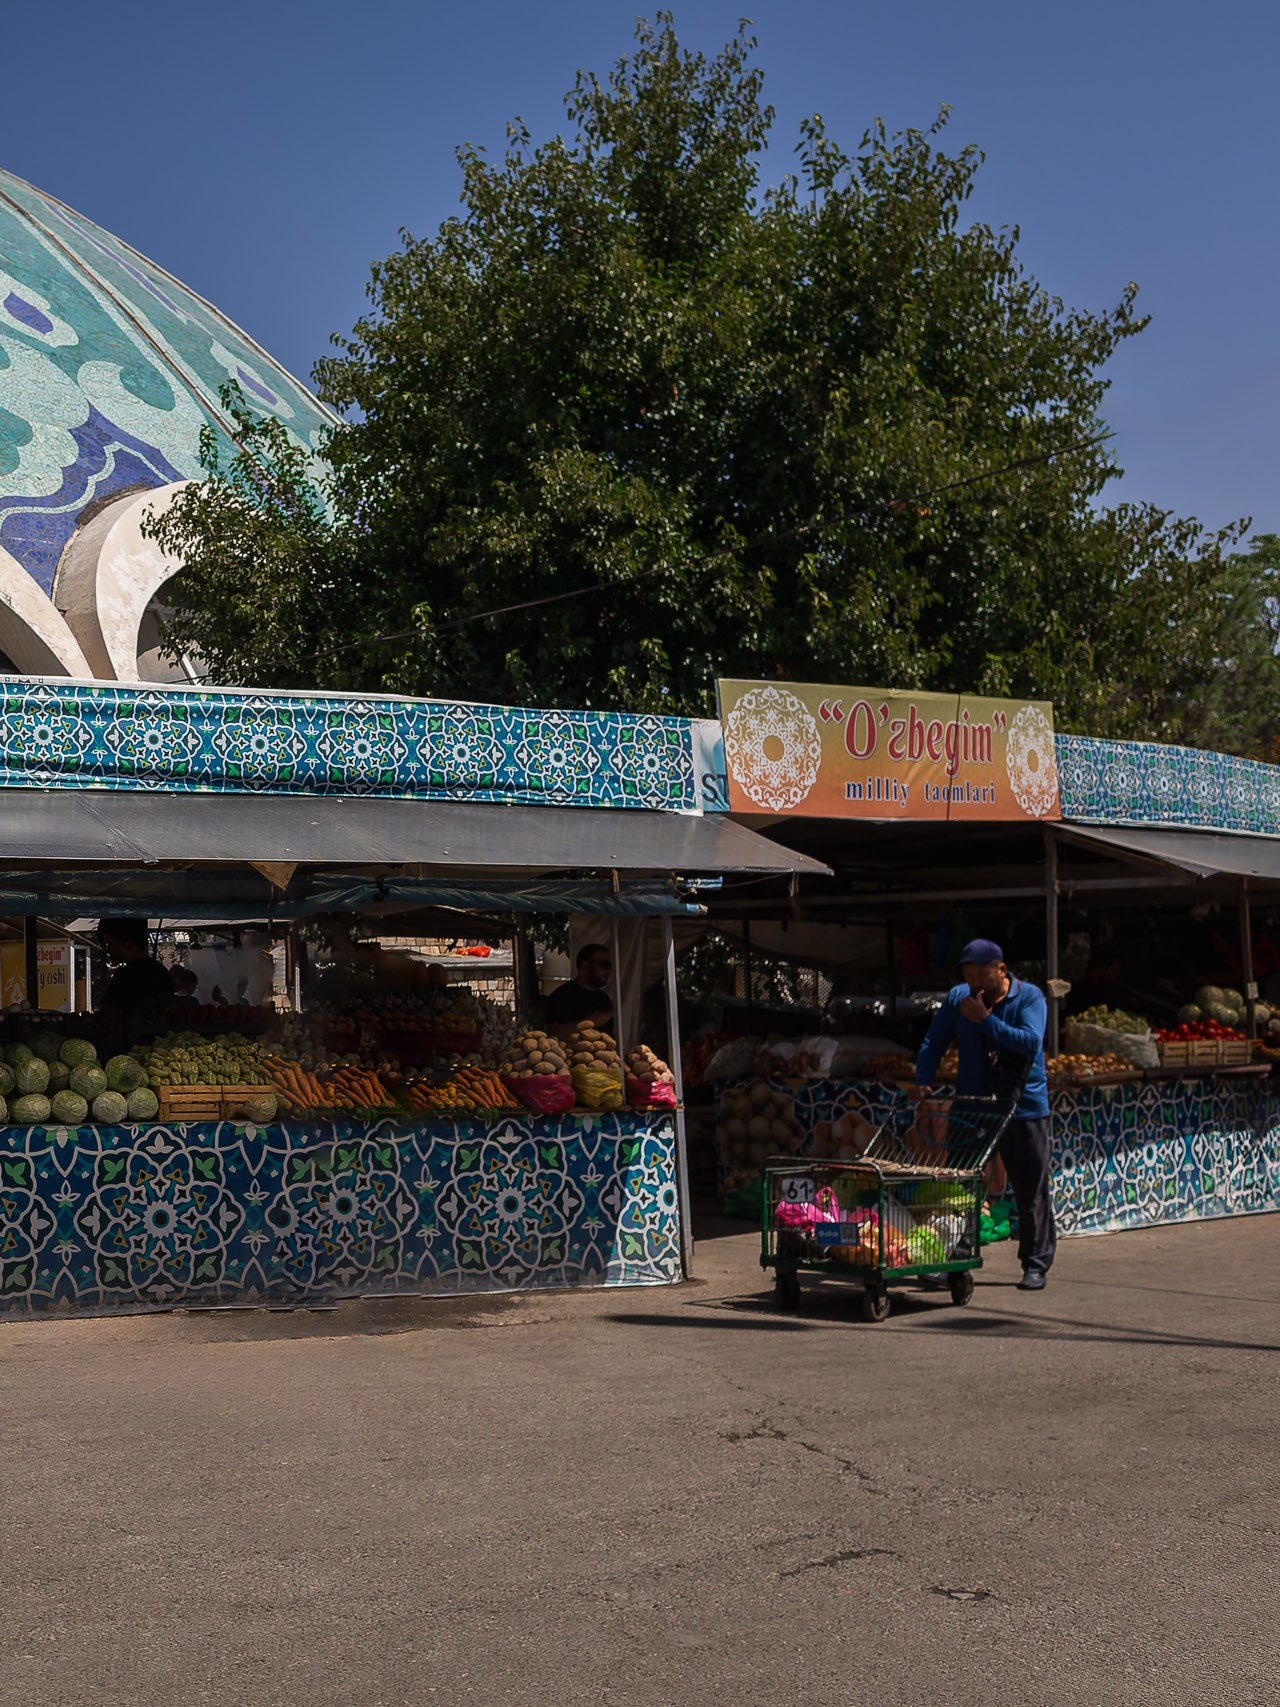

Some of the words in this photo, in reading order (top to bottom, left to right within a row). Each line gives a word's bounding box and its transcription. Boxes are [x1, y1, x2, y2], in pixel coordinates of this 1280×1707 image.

[845, 776, 910, 807] milliy
[923, 779, 997, 804] taomlari
[48, 968, 65, 985] oshi
[787, 1181, 809, 1199] 61
